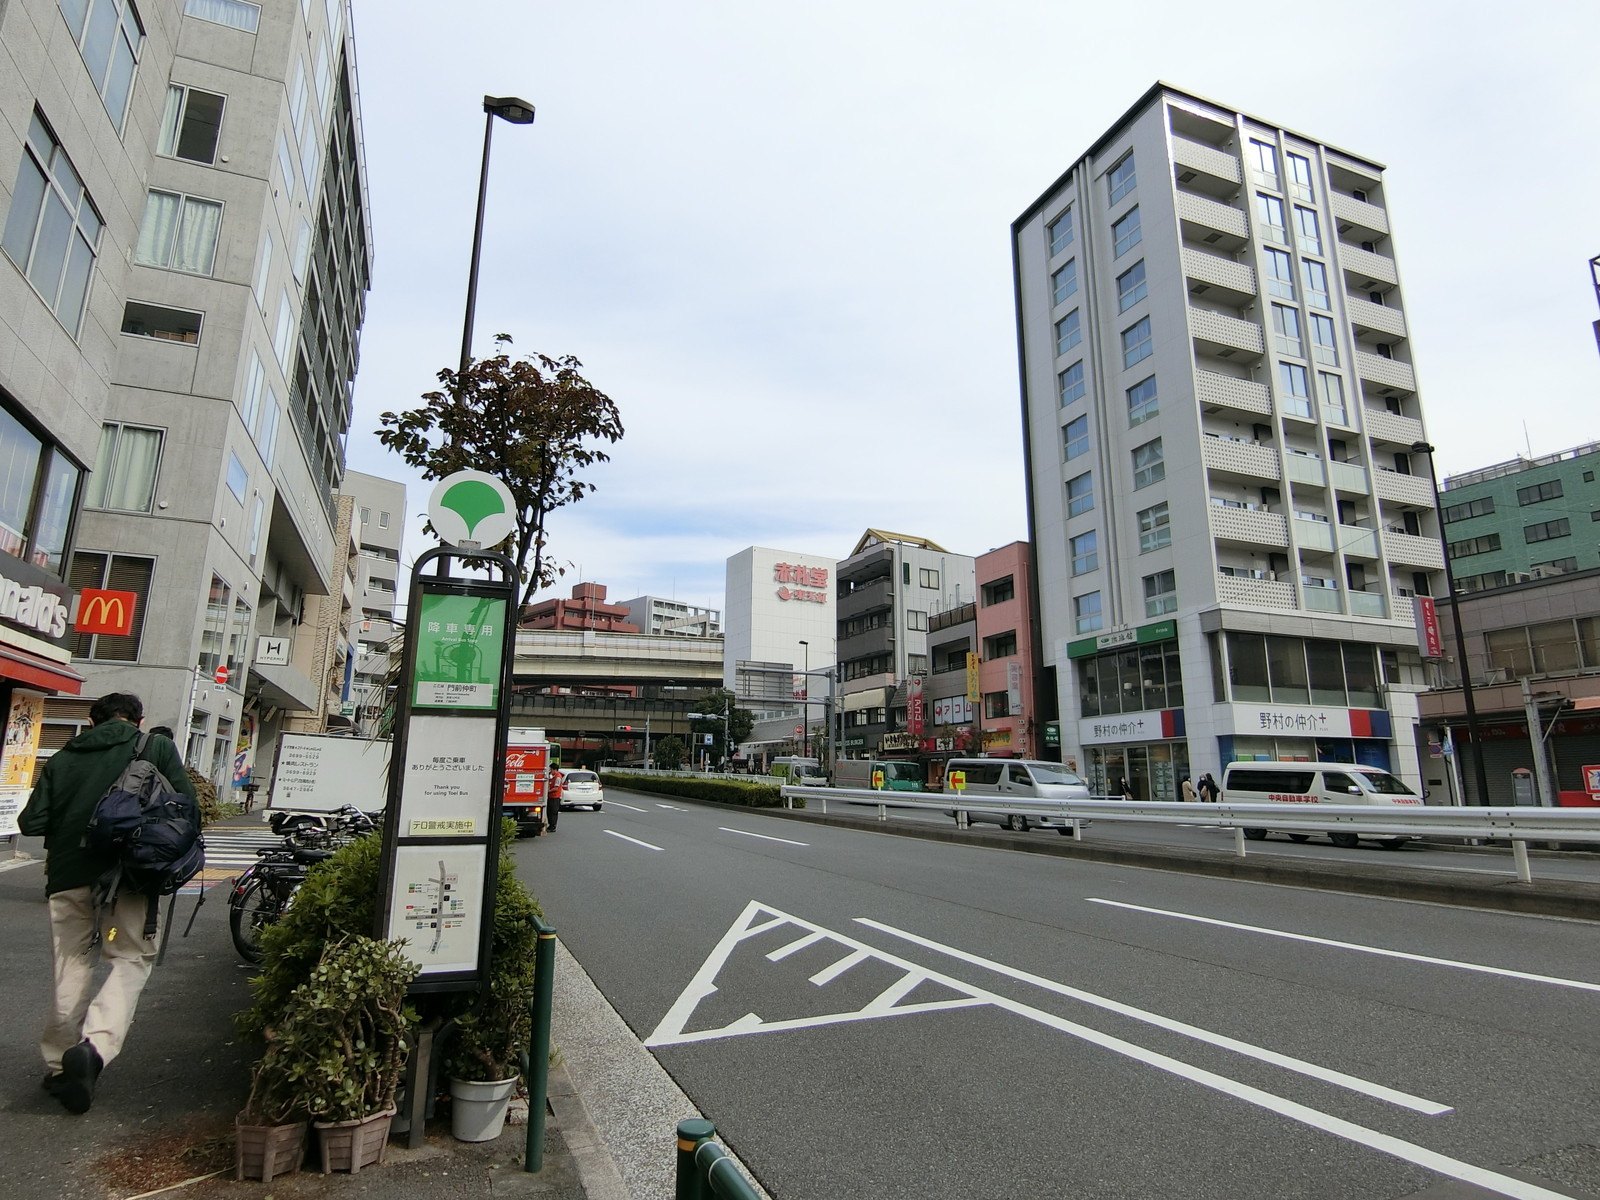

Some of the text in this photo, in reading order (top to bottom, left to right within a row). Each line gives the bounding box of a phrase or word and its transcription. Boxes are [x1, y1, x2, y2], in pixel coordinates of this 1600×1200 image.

[774, 562, 828, 588] 赤札堂
[0, 573, 68, 638] nald's
[427, 621, 493, 637] 降車専用
[446, 684, 477, 692] 門前仲町
[914, 699, 922, 721] アコム
[944, 701, 973, 715] アコム
[432, 756, 466, 764] 毎度ご乗車
[411, 764, 485, 772] ありがとうございました
[1268, 794, 1319, 804] 中央自動車学校
[412, 820, 473, 830] テロ警戒実施中
